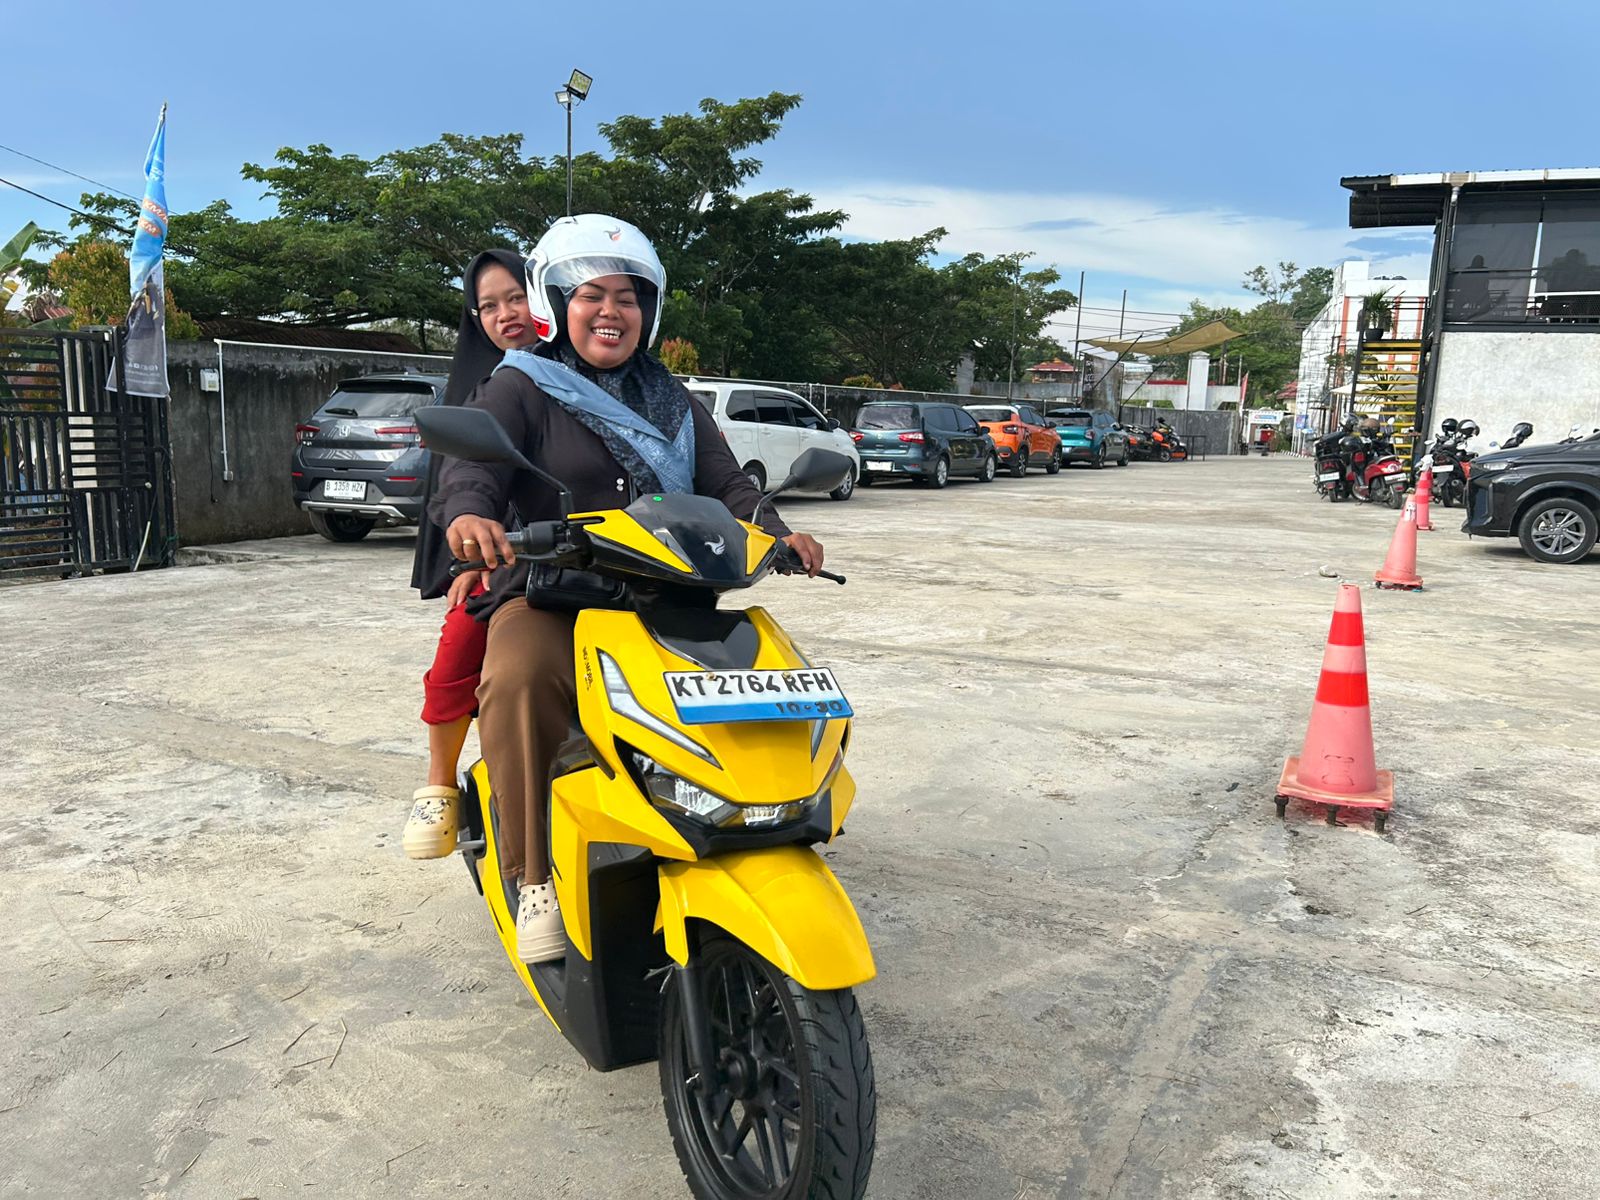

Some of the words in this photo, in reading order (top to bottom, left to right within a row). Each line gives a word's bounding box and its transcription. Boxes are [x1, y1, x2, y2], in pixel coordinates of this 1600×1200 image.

[325, 481, 331, 491] B
[671, 675, 707, 697] KT
[714, 674, 781, 695] 2764
[781, 672, 833, 693] RFH
